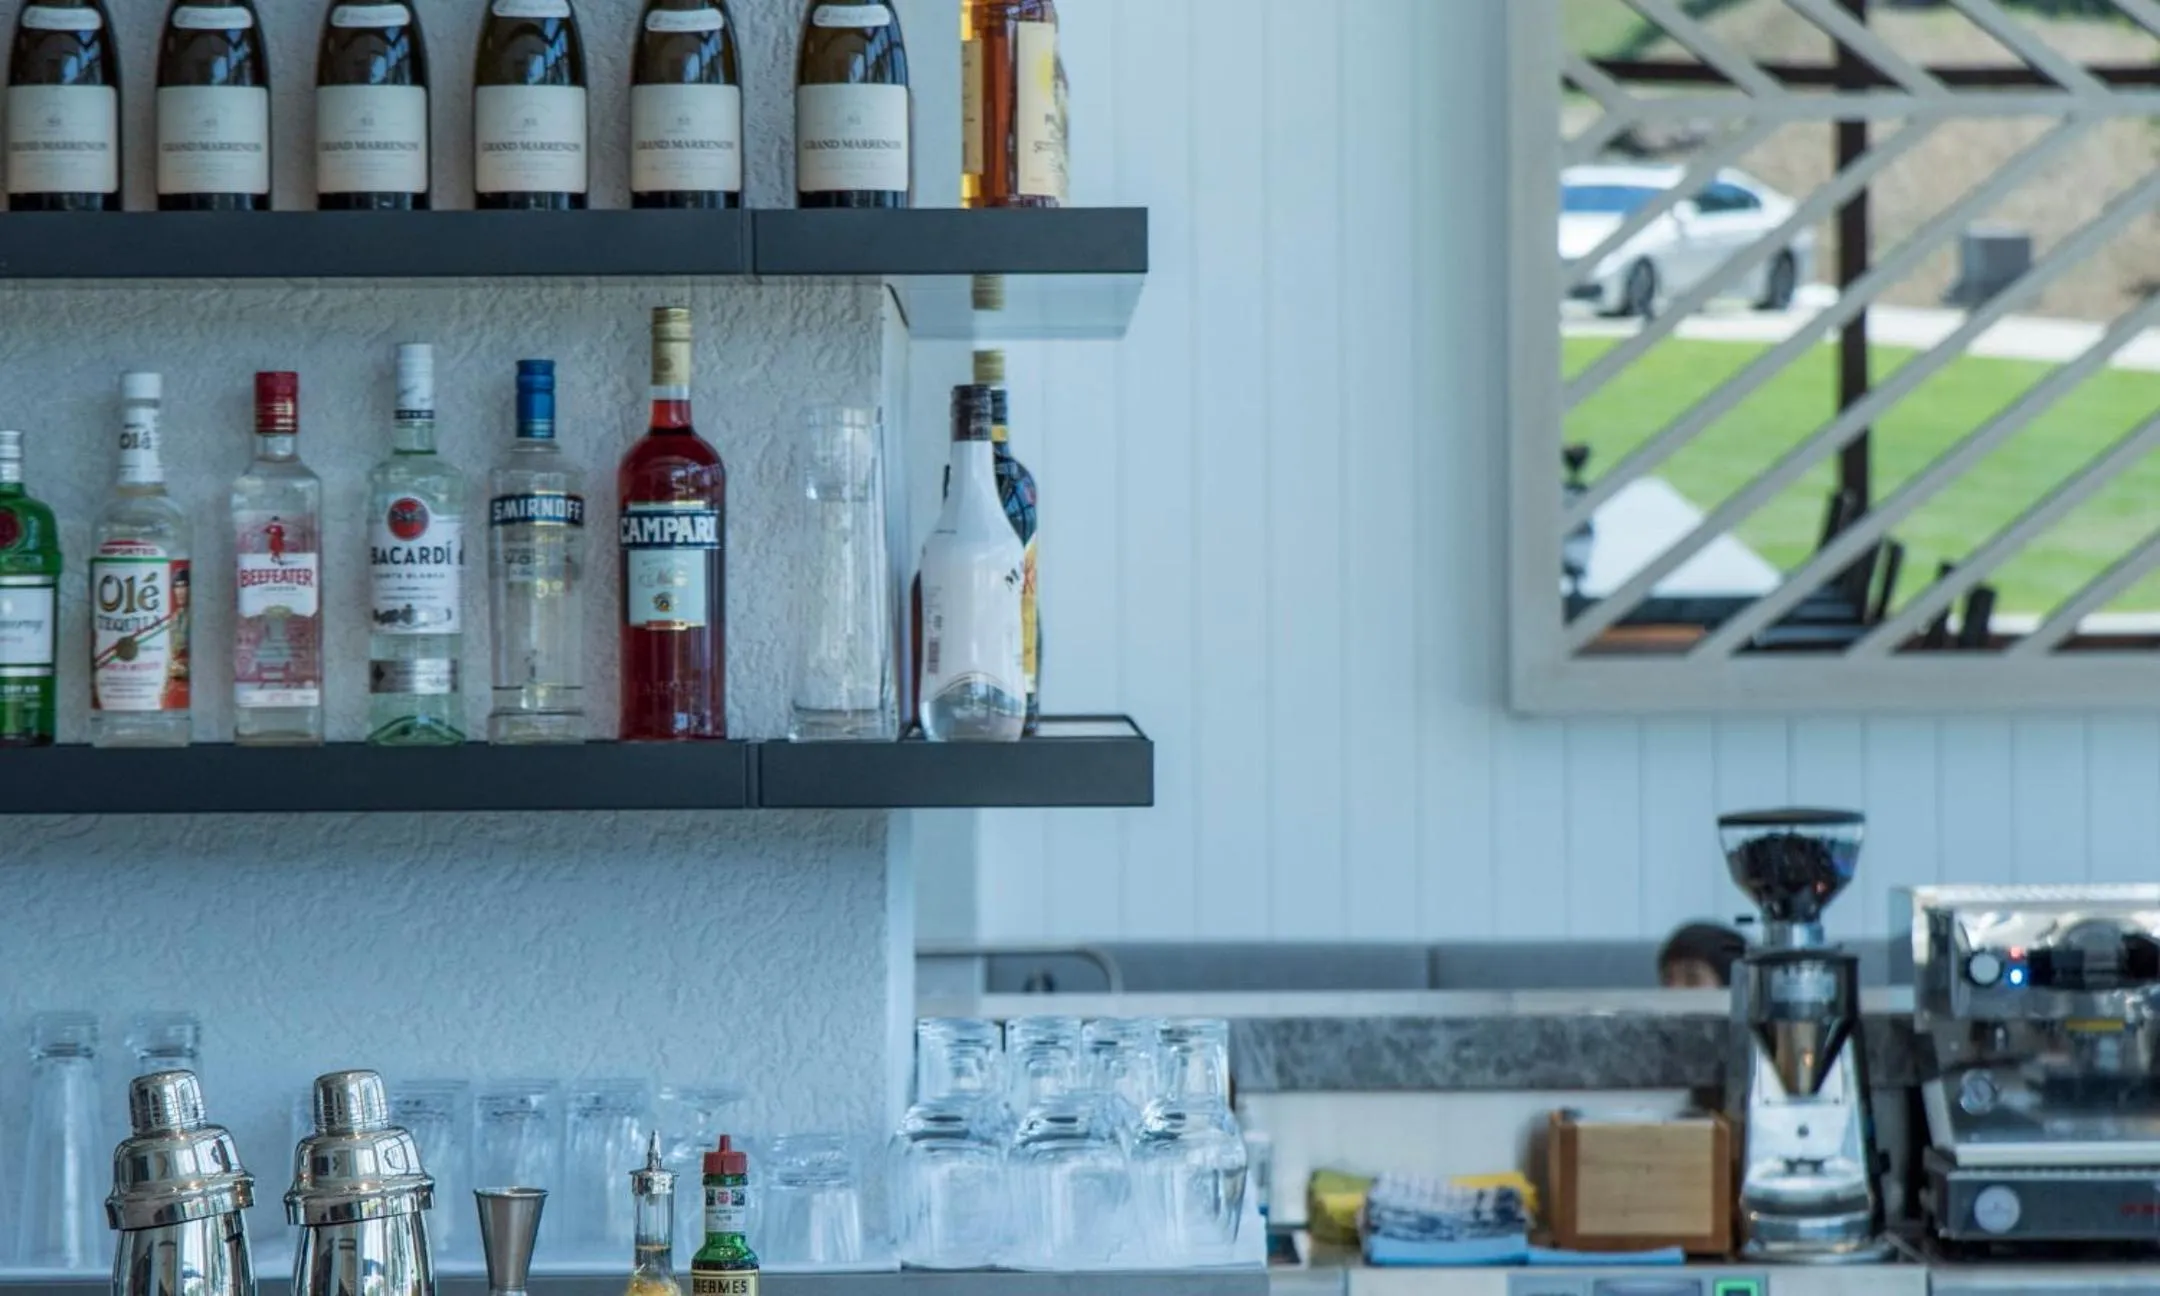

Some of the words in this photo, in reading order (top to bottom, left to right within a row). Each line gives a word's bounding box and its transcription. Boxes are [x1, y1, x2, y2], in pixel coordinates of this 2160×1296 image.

[493, 497, 582, 521] SMIRNOFF
[620, 515, 719, 544] CAMPARI
[371, 541, 452, 566] BACARDÍ
[239, 568, 314, 588] BEEFEATER
[98, 571, 160, 615] Olé
[693, 1279, 747, 1294] HERMES
